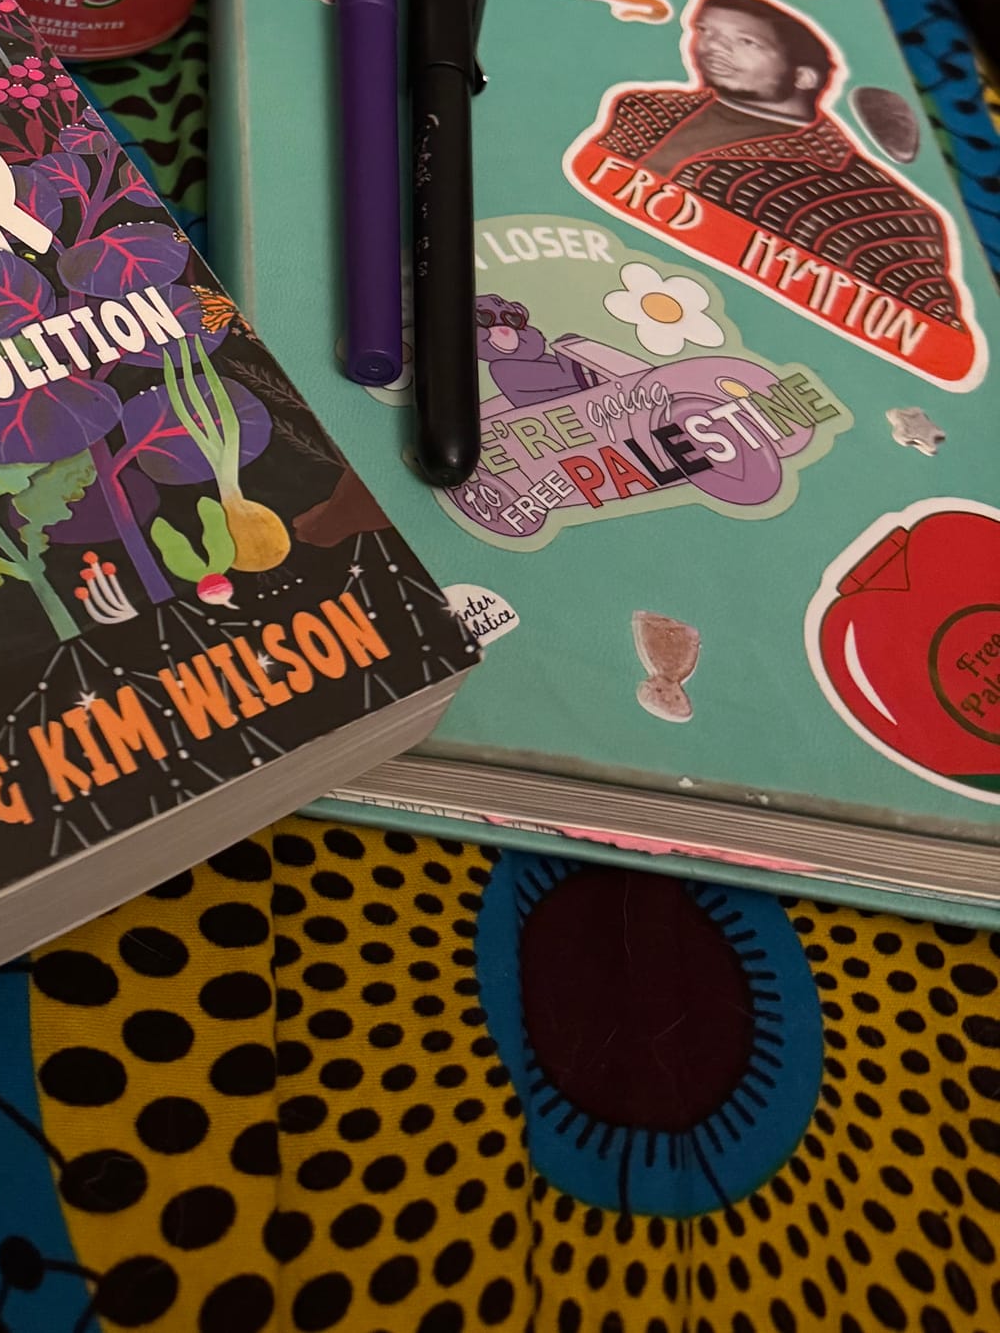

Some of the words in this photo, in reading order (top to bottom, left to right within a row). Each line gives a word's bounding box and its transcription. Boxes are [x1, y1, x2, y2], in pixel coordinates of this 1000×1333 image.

[590, 157, 703, 231] FRED
[483, 226, 614, 264] LOSER
[741, 230, 931, 358] HAMPTON
[463, 484, 503, 523] to
[499, 469, 577, 535] FREE
[559, 372, 841, 510] PALESTINE
[587, 380, 674, 442] going
[29, 685, 165, 804] KIM
[158, 590, 393, 742] WILSON
